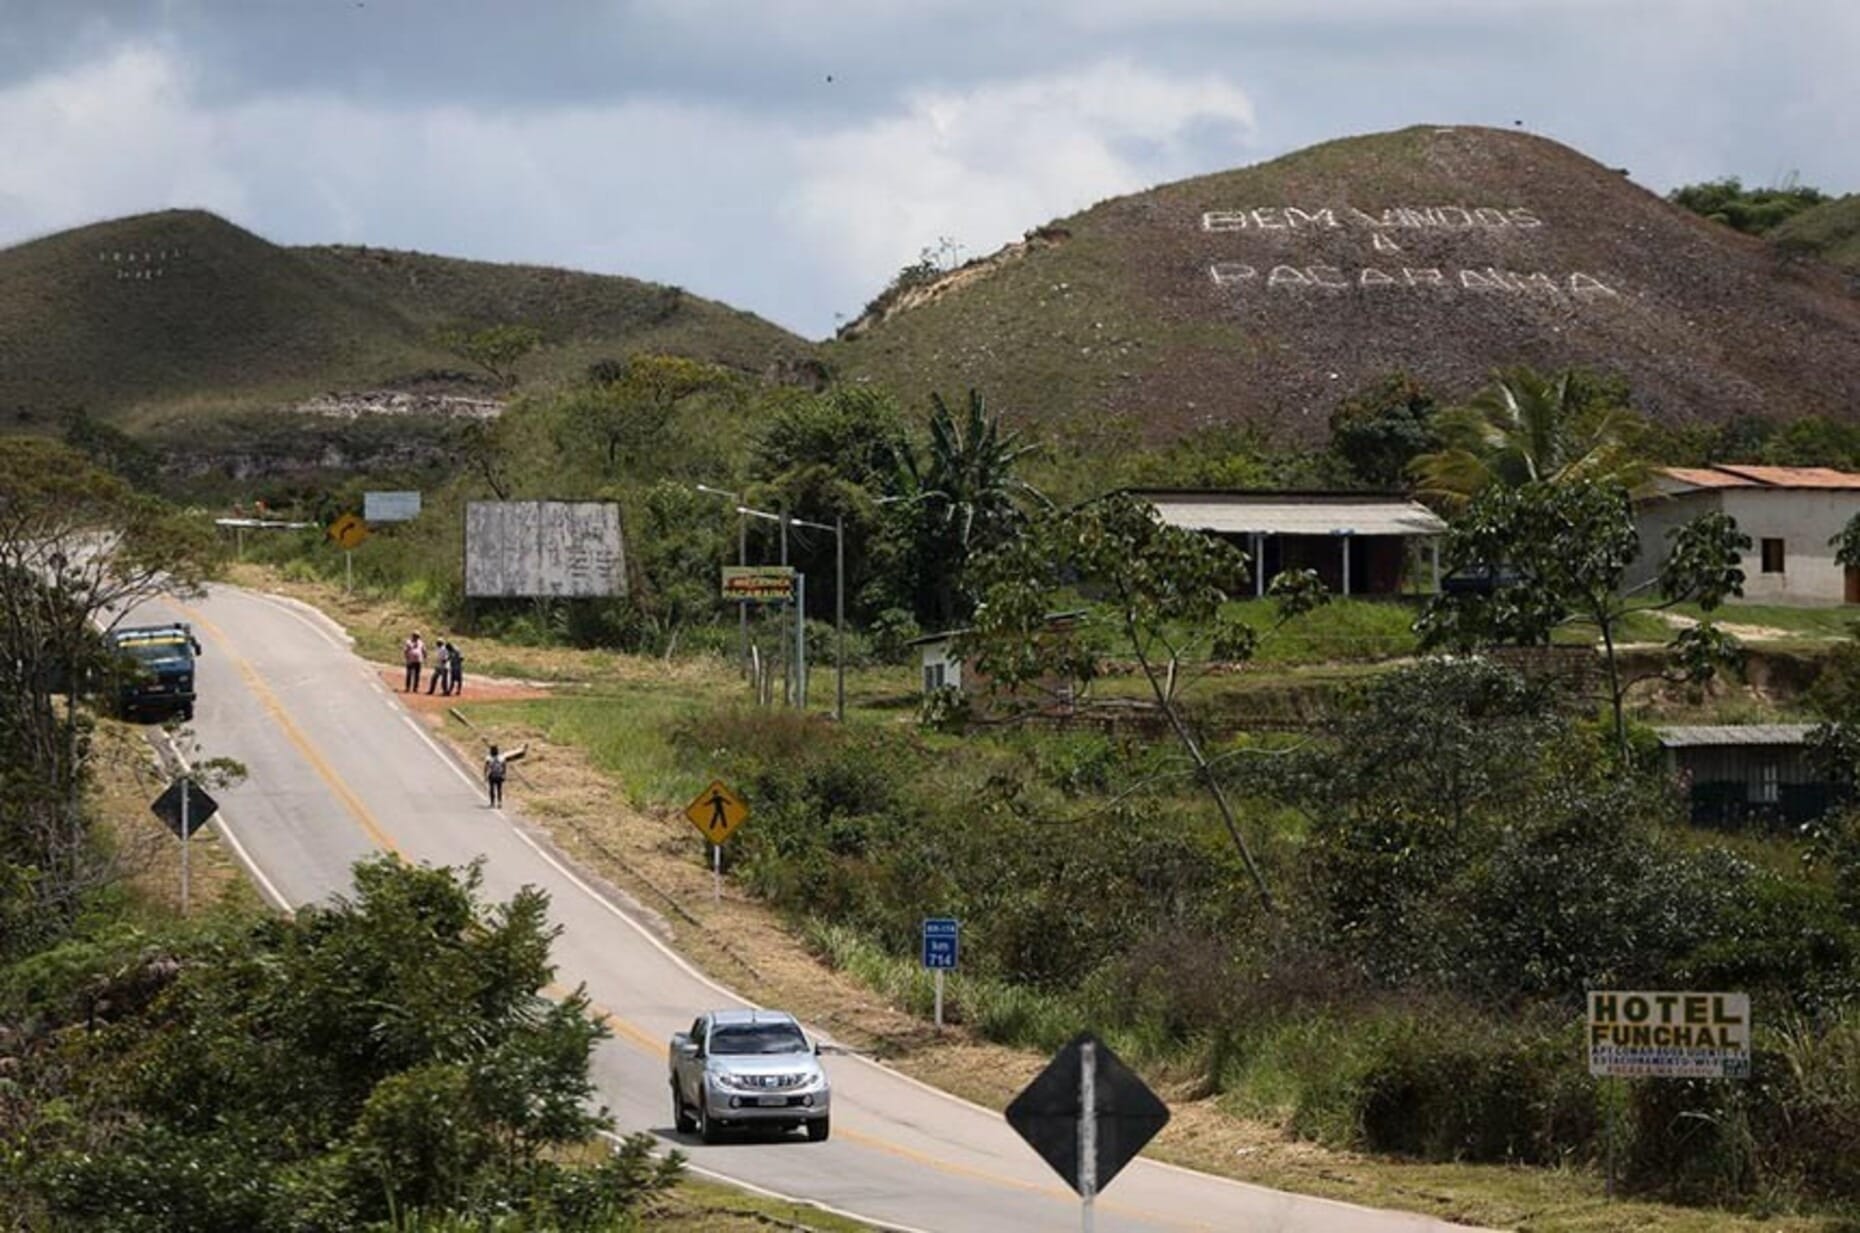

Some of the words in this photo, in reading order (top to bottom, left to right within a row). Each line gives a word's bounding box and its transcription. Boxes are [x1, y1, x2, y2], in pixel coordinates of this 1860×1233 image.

[1202, 207, 1339, 231] BEM
[1352, 206, 1543, 228] VINDOS
[931, 940, 950, 952] km
[1594, 995, 1742, 1024] HOTEL
[1591, 1025, 1741, 1048] FUNCHAL
